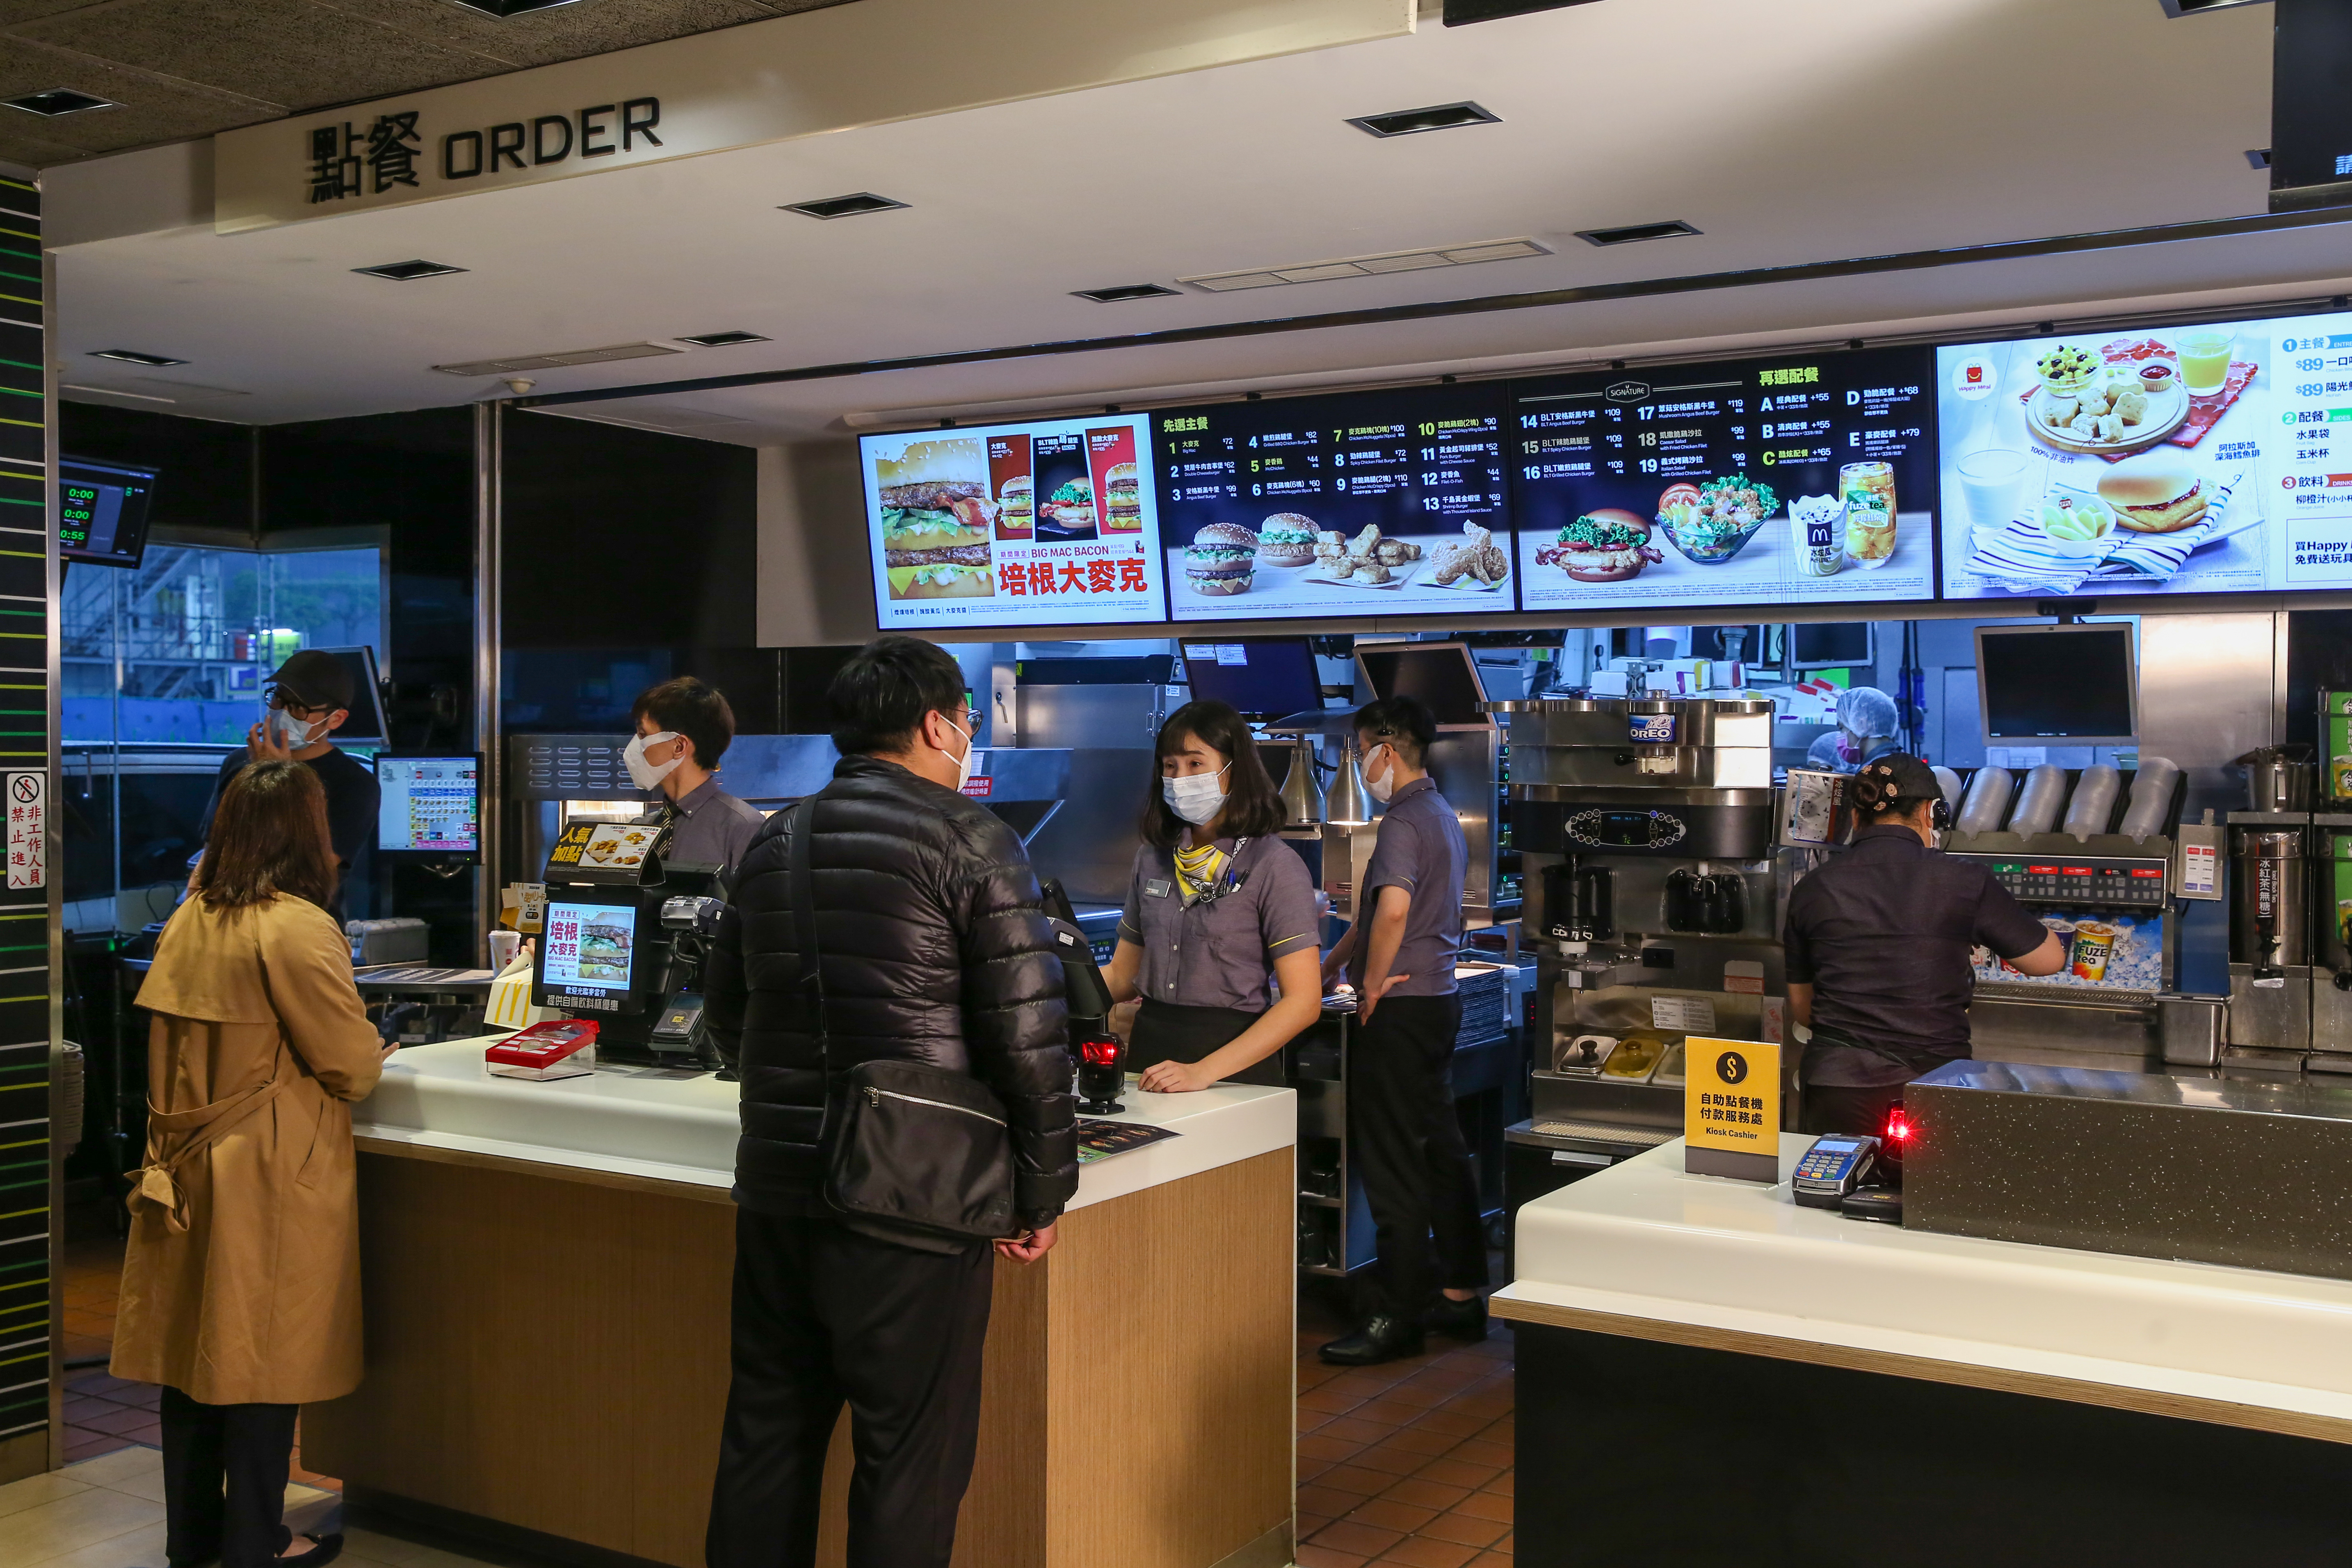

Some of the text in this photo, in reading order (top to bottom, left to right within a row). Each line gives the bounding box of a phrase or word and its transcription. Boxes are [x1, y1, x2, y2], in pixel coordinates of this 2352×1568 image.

[445, 96, 663, 180] ORDER
[312, 111, 420, 204] 點餐
[2299, 338, 2324, 349] 主餐
[2296, 358, 2323, 371] $89
[1759, 367, 1819, 386] 再選配餐
[1611, 385, 1644, 397] SIGNATURE
[1847, 390, 1860, 405] D
[1864, 388, 1895, 398] 勁脆配餐
[2295, 383, 2323, 397] $89
[1637, 399, 1743, 420] 17 $119
[1761, 397, 1774, 411] A
[1777, 395, 1806, 404] 經典配餐
[1520, 415, 1538, 428] 14
[1605, 409, 1621, 417] $109
[2299, 411, 2323, 422] 配餐
[1164, 417, 1208, 432] 先選主餐
[1418, 422, 1435, 436] 10
[1762, 424, 1774, 438] B
[1778, 422, 1807, 431] 清爽配餐
[1334, 429, 1343, 442] 7
[1391, 425, 1404, 433] $100
[1638, 433, 1657, 446] 18
[1850, 432, 1860, 447] E
[1865, 429, 1896, 439] 豪麥配餐
[2296, 429, 2329, 440] 水果袋
[1169, 443, 1176, 454] 1
[1249, 436, 1258, 448] 4
[1522, 441, 1539, 454] 15
[2219, 441, 2255, 452] 阿拉斯加
[1421, 447, 1435, 461] 11
[1439, 444, 1484, 454] 黃金起司豬排堡
[1763, 451, 1775, 466] C
[1779, 449, 1809, 459] 酷炫配餐
[2031, 446, 2075, 465] 100% 非油炸
[2296, 448, 2329, 459] 玉米杯
[1251, 460, 1259, 472] 5
[1335, 454, 1345, 467] 8
[1640, 459, 1658, 473] 19
[1171, 466, 1179, 477] 2
[1184, 462, 1223, 471] 雙層牛肉吉事堡
[1523, 461, 1623, 479] 16 $109
[1336, 478, 1346, 491] 9
[1422, 472, 1438, 486] 12
[1441, 470, 1460, 479] 麥香魚
[2299, 476, 2323, 487] 飲料
[69, 488, 94, 499] 0:00
[1172, 489, 1181, 501] 3
[1186, 486, 1219, 495] 安格斯黑牛堡
[1252, 484, 1261, 496] 6
[1423, 497, 1440, 511] 13
[1442, 494, 1481, 503] 千島黃金蝦堡
[64, 509, 89, 520] 0:00
[60, 530, 85, 540] 0:55
[1031, 546, 1109, 558] BIG MAC BACON
[999, 557, 1148, 596] 培根大麥克
[1631, 729, 1670, 738] OREO
[1833, 780, 1844, 806] 冰炫風
[560, 827, 593, 843] 人氣
[11, 806, 27, 886] 禁止進入
[27, 805, 43, 885] 非工作人員
[550, 845, 583, 863] 加點
[2259, 858, 2270, 914] 冰紅茶(無糖)
[550, 920, 578, 941] 培根
[548, 942, 577, 956] 大麥克
[2078, 945, 2108, 956] FUZE
[2077, 954, 2096, 964] tea
[565, 986, 606, 997] 歡迎光臨麥當勞
[547, 994, 619, 1011] 提供自備飲料杯優惠
[1701, 1093, 1763, 1110] 自助點餐機
[1700, 1107, 1763, 1125] 付款服務處
[1706, 1127, 1758, 1140] Kiosk Cashier
